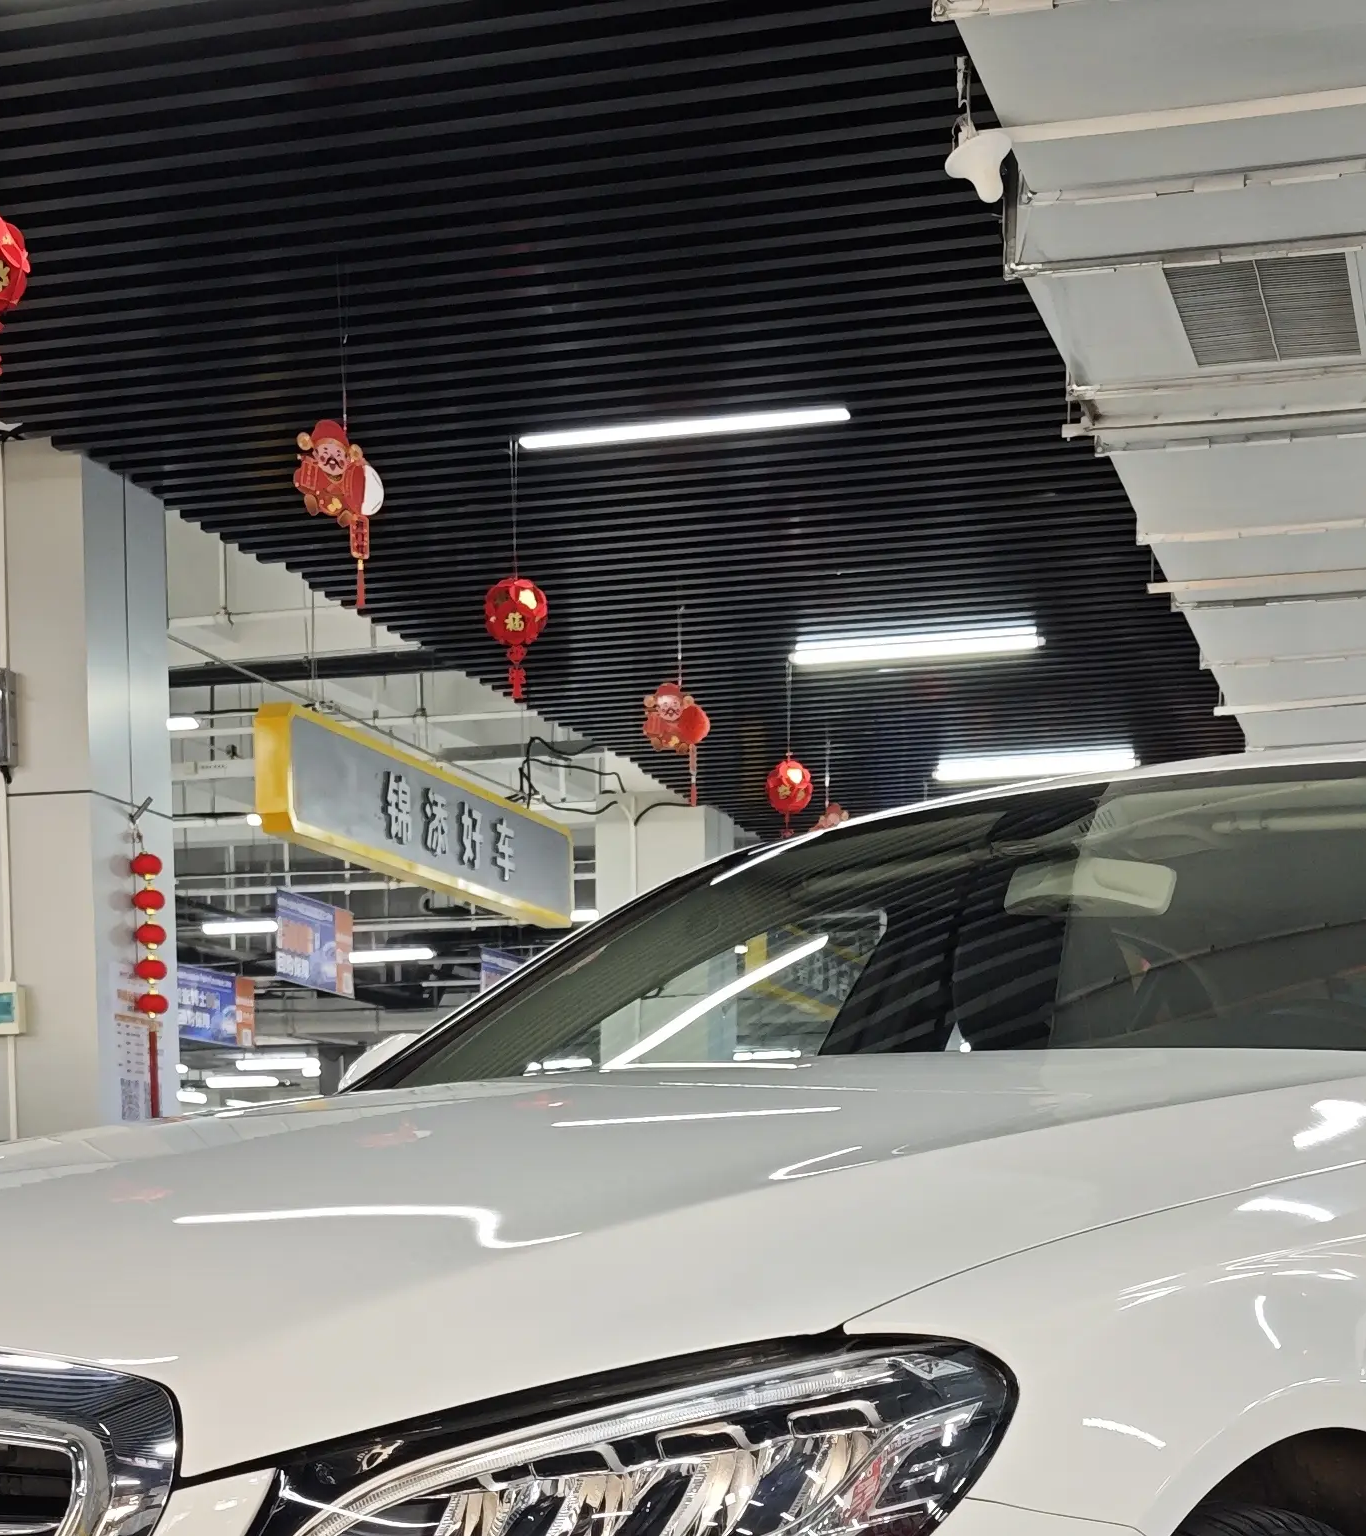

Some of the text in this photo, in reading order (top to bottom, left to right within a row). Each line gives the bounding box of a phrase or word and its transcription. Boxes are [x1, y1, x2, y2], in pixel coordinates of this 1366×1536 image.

[504, 612, 525, 632] 福
[383, 771, 517, 882] 锦添好车
